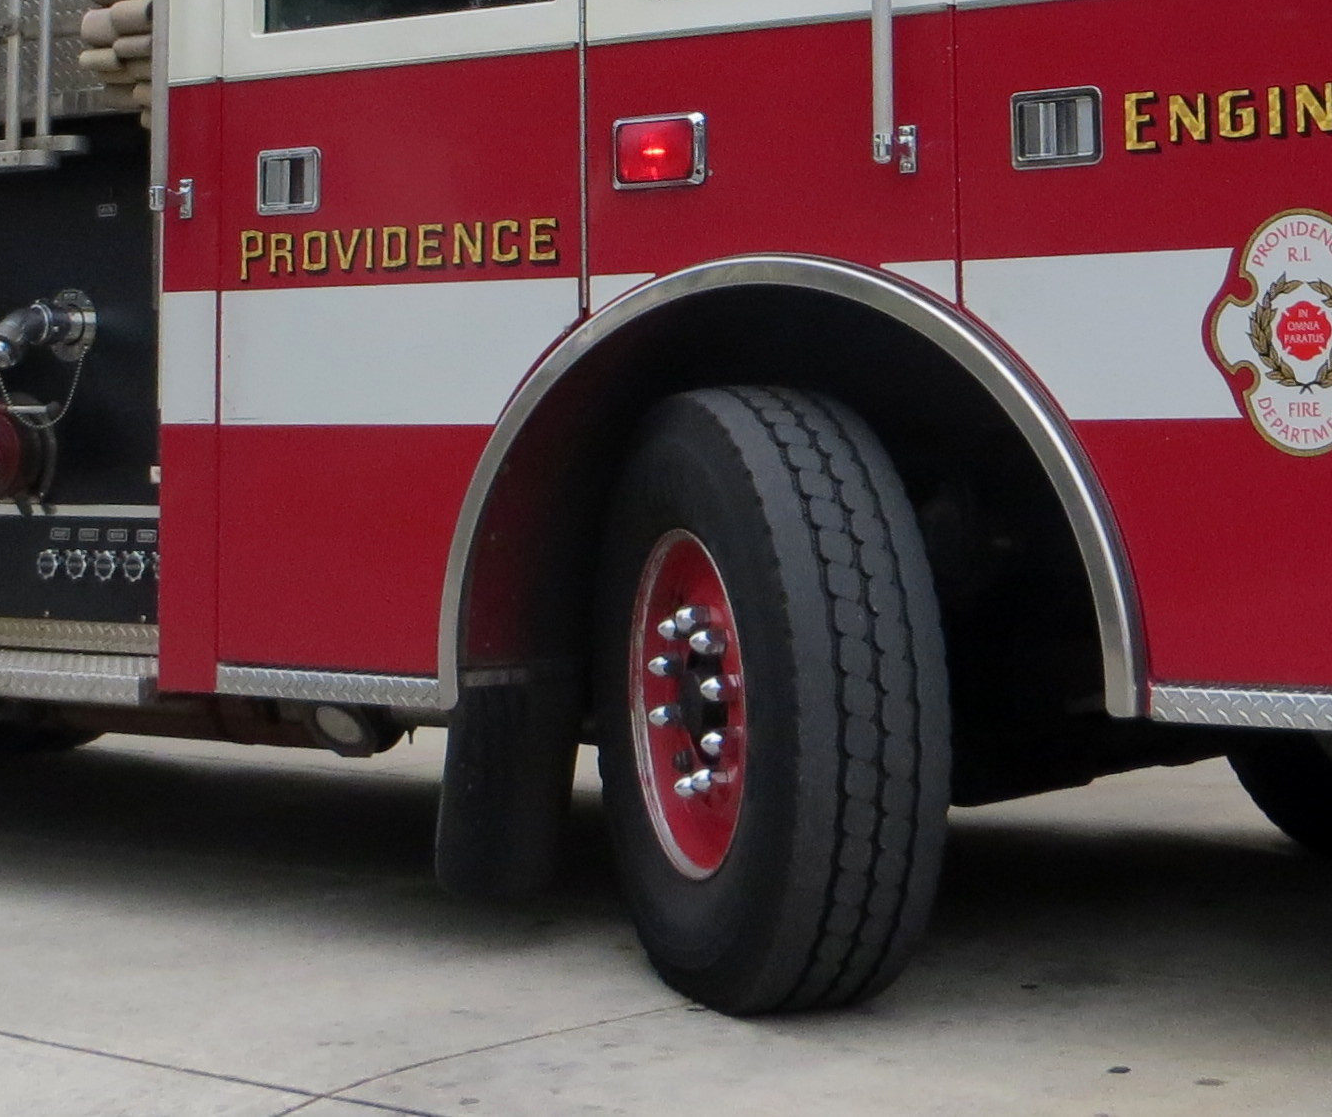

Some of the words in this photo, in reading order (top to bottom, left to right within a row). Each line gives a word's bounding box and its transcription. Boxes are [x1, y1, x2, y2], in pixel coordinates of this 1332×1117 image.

[240, 216, 559, 281] PROVIDENCE
[1288, 246, 1312, 262] R.I.
[1298, 308, 1309, 318] IN
[1287, 321, 1321, 331] OMNIA
[1284, 333, 1326, 344] PARATUS
[1288, 402, 1321, 417] FIRE
